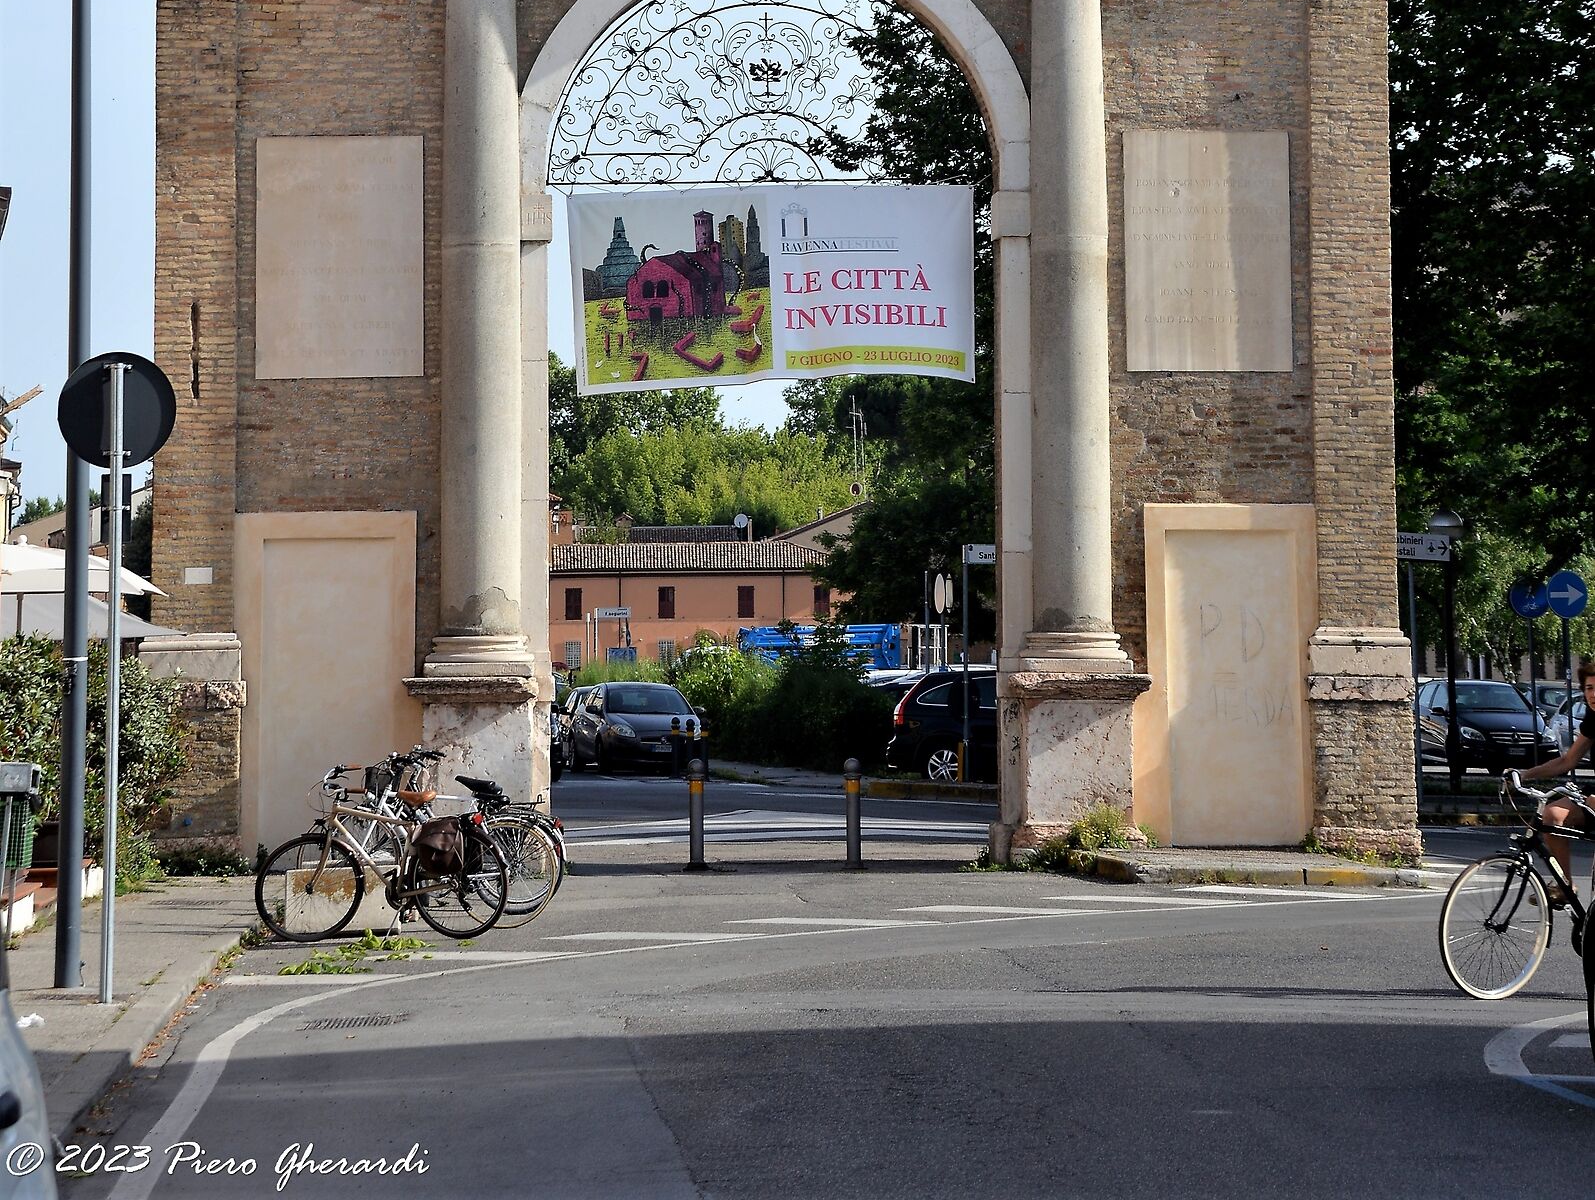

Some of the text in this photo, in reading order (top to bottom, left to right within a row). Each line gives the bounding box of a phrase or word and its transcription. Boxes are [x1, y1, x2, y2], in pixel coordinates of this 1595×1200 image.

[781, 239, 898, 252] RAVENNA FESTIVAL
[783, 263, 931, 294] LE CITTÀ
[784, 303, 948, 330] INVISIBILI
[790, 355, 796, 366] 7
[800, 350, 853, 367] GIUGNO
[863, 350, 877, 362] 23
[880, 350, 932, 363] LUGLIO
[935, 354, 960, 367] 2023
[1397, 547, 1416, 557] stali
